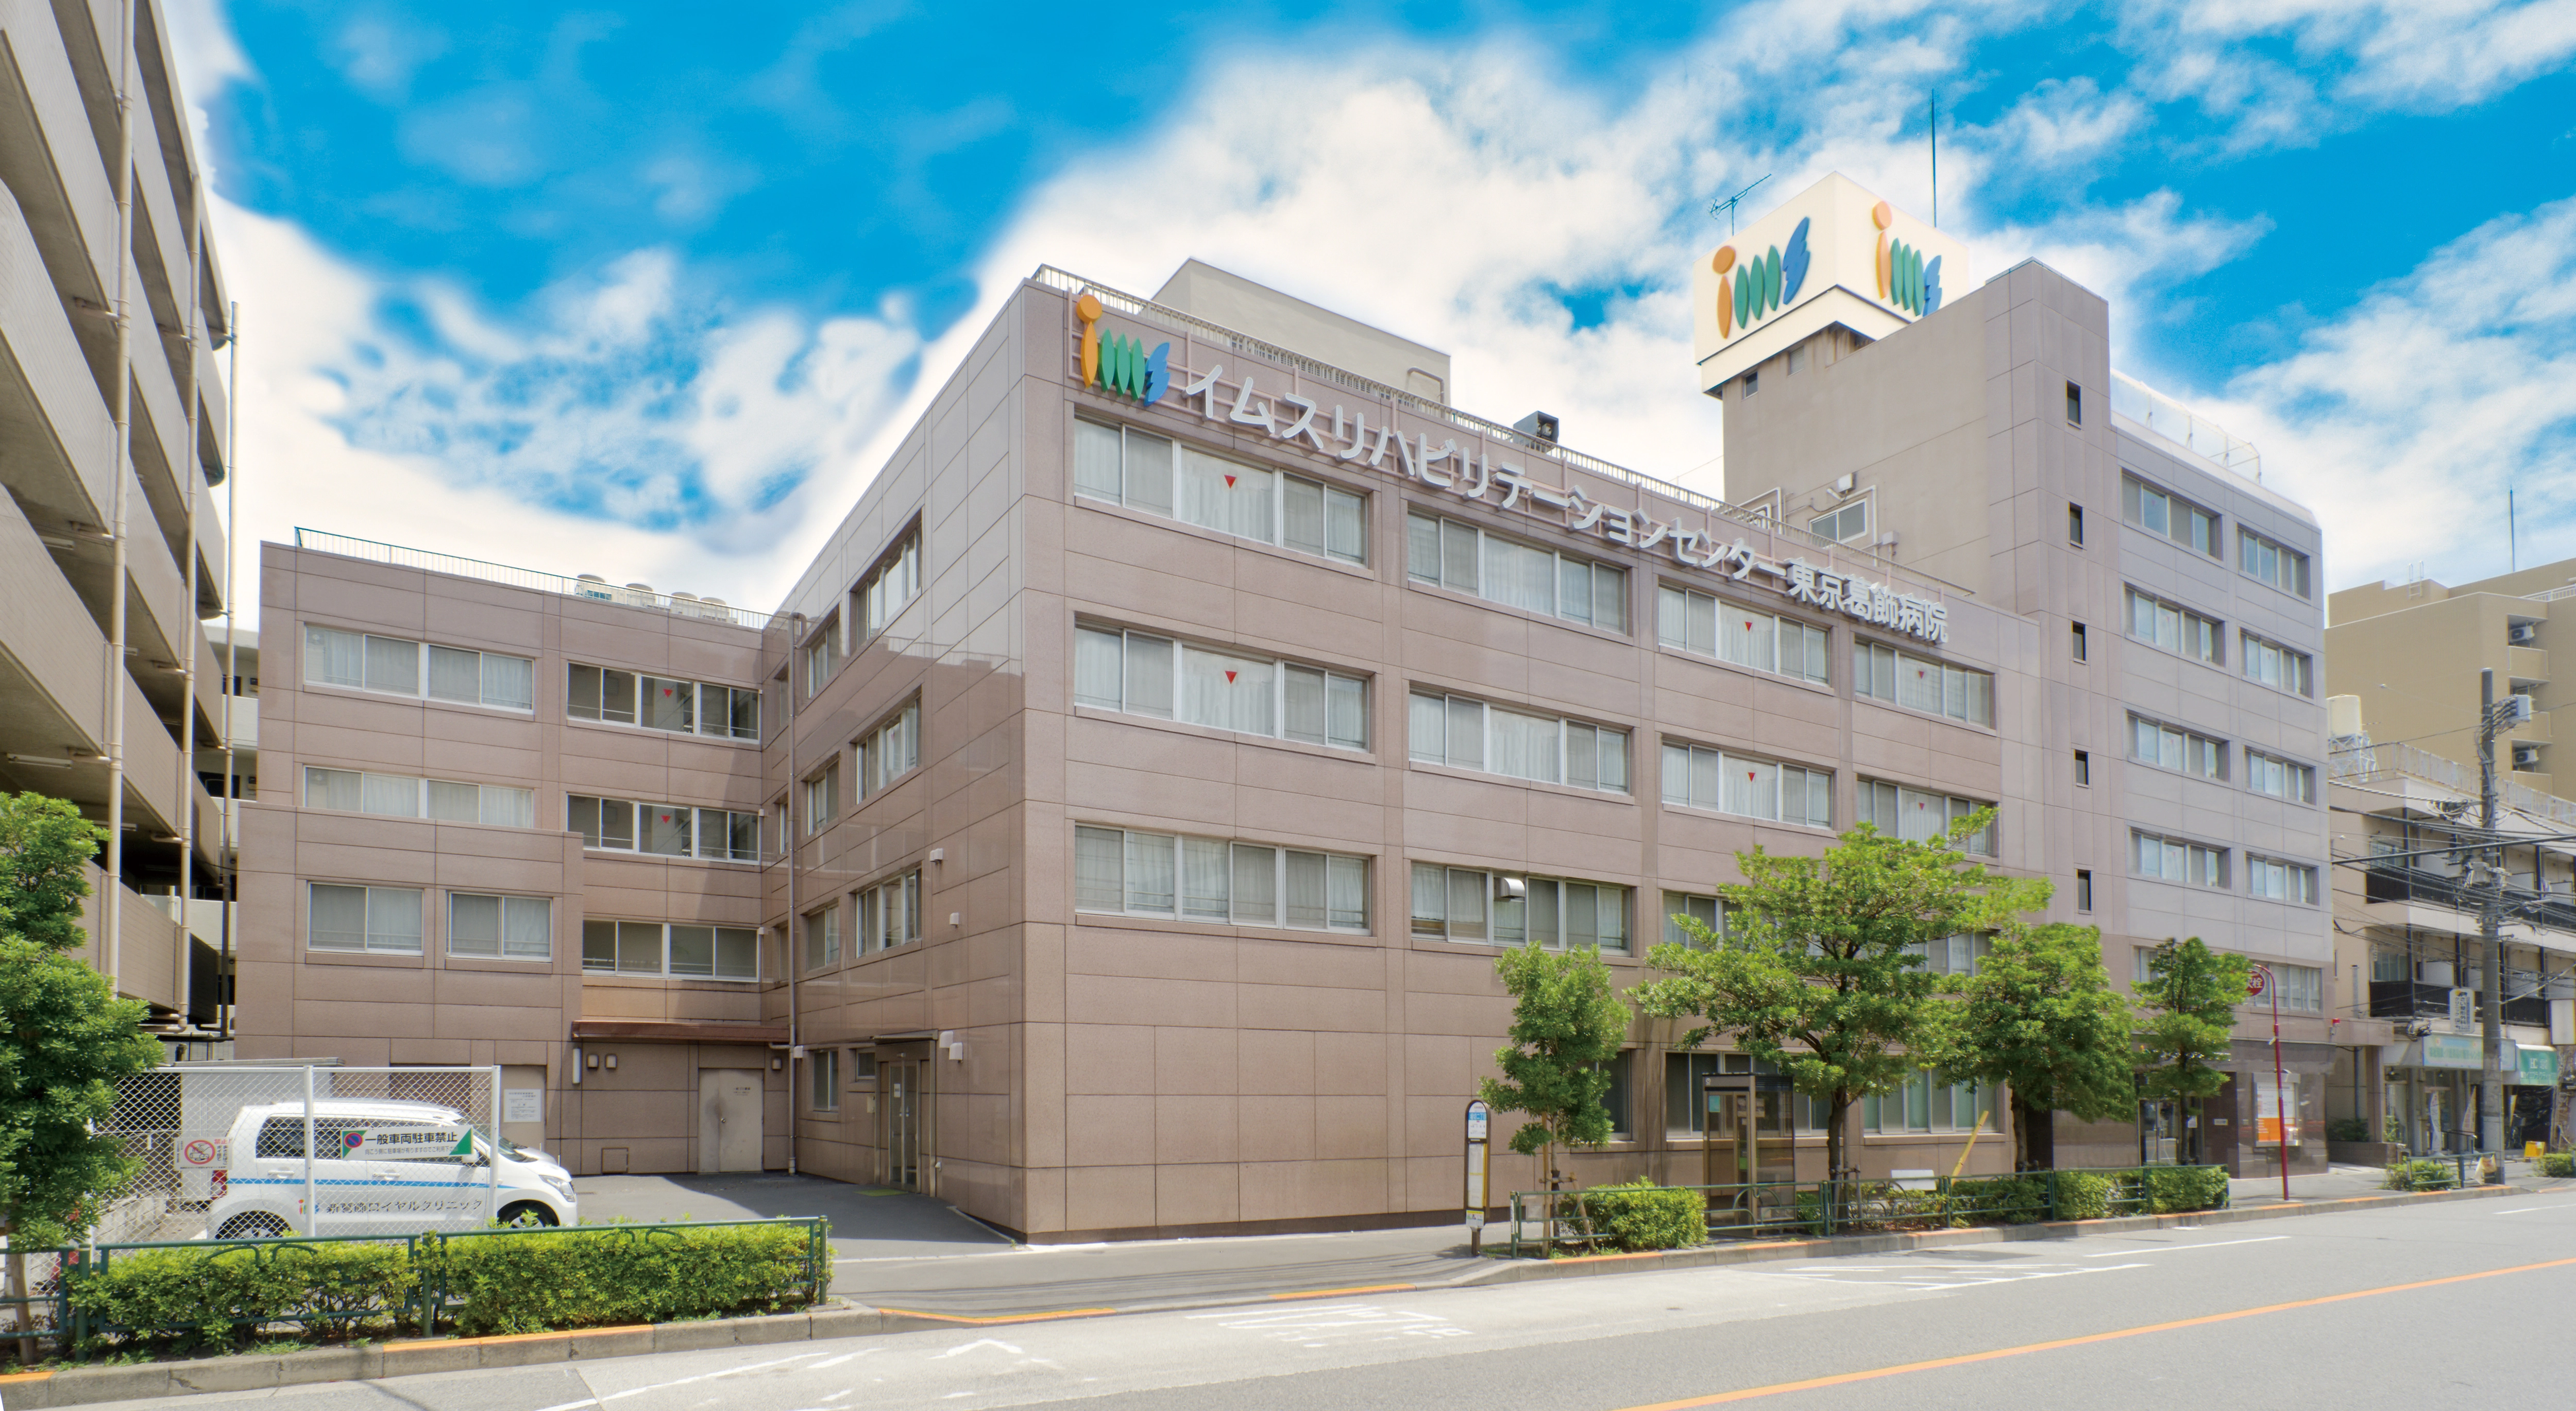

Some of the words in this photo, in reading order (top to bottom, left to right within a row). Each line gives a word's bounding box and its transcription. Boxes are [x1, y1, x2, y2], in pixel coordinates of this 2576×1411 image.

[365, 1132, 457, 1145] 一般車両駐車禁止
